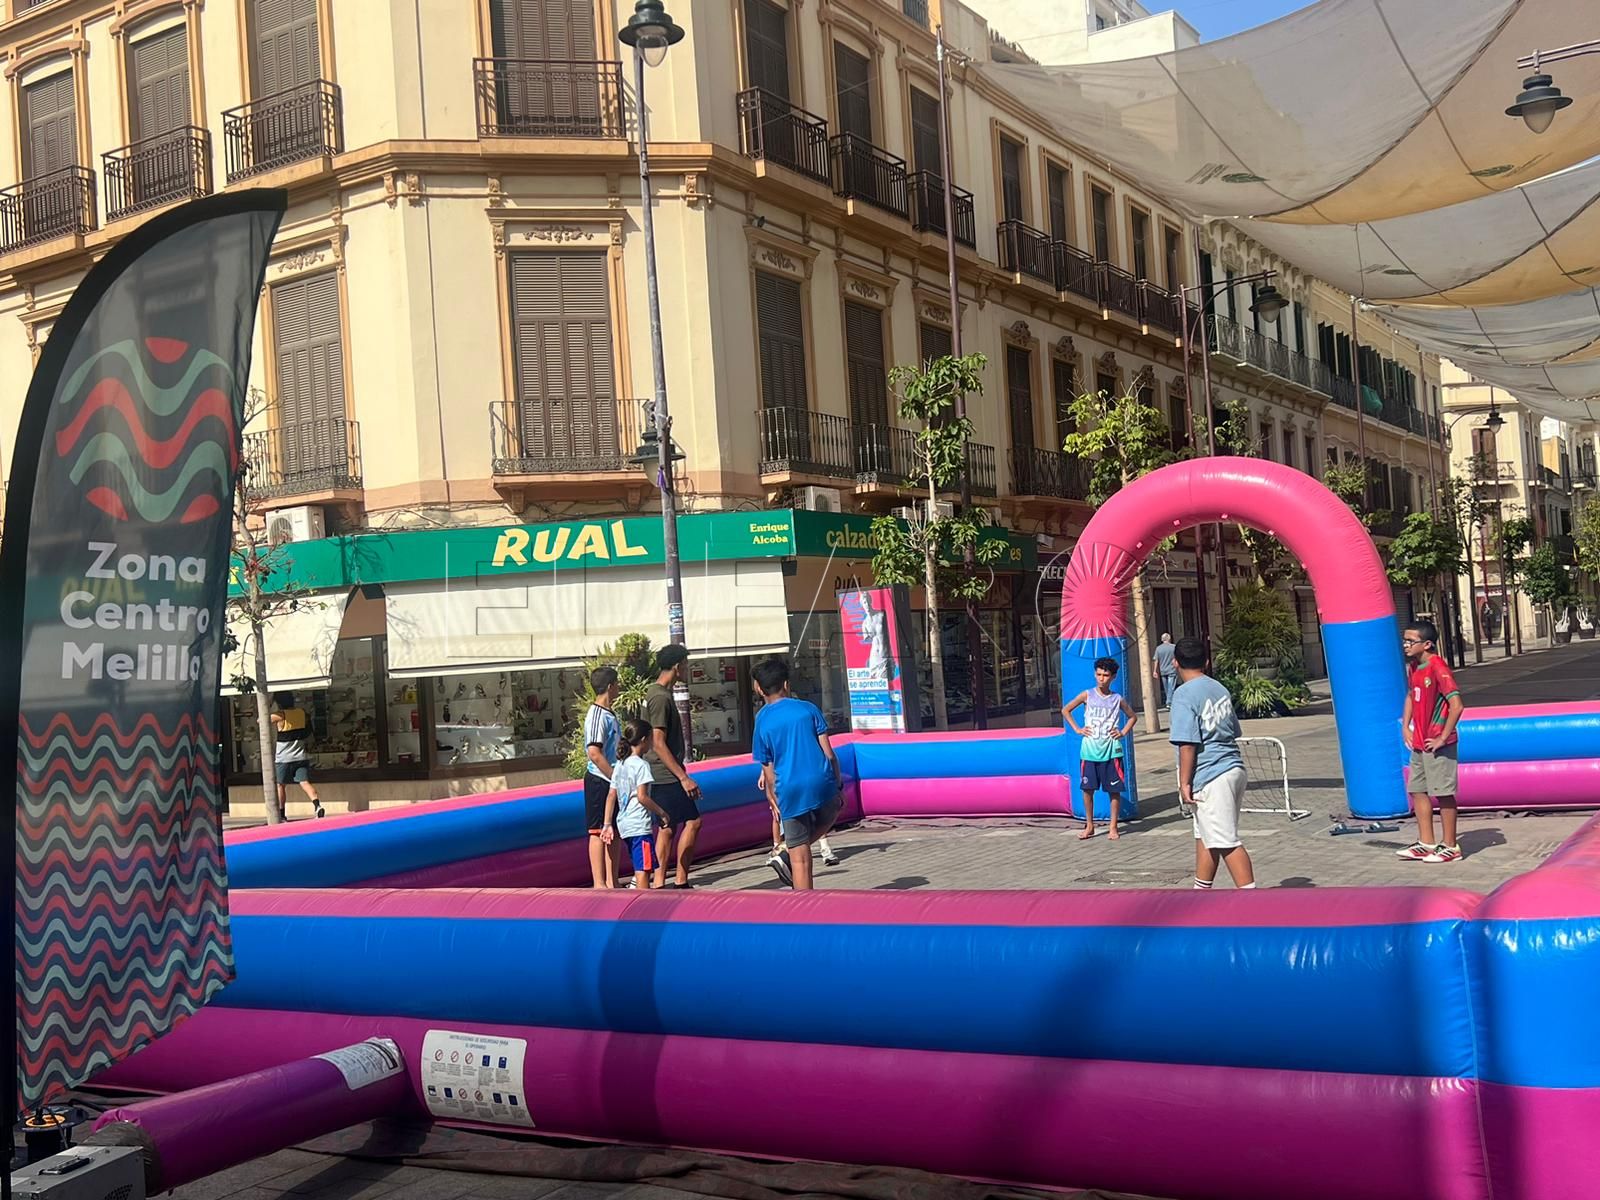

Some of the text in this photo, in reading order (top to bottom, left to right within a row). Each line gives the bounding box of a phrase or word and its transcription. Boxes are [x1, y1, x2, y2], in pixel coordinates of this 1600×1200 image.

[491, 519, 649, 567] RUAL
[749, 523, 789, 534] Enrique
[752, 534, 788, 545] Alcoba
[826, 523, 883, 549] calzad
[85, 541, 206, 584] Zona
[60, 590, 210, 634] Centro
[61, 641, 200, 682] Melilla
[858, 680, 887, 688] aprende
